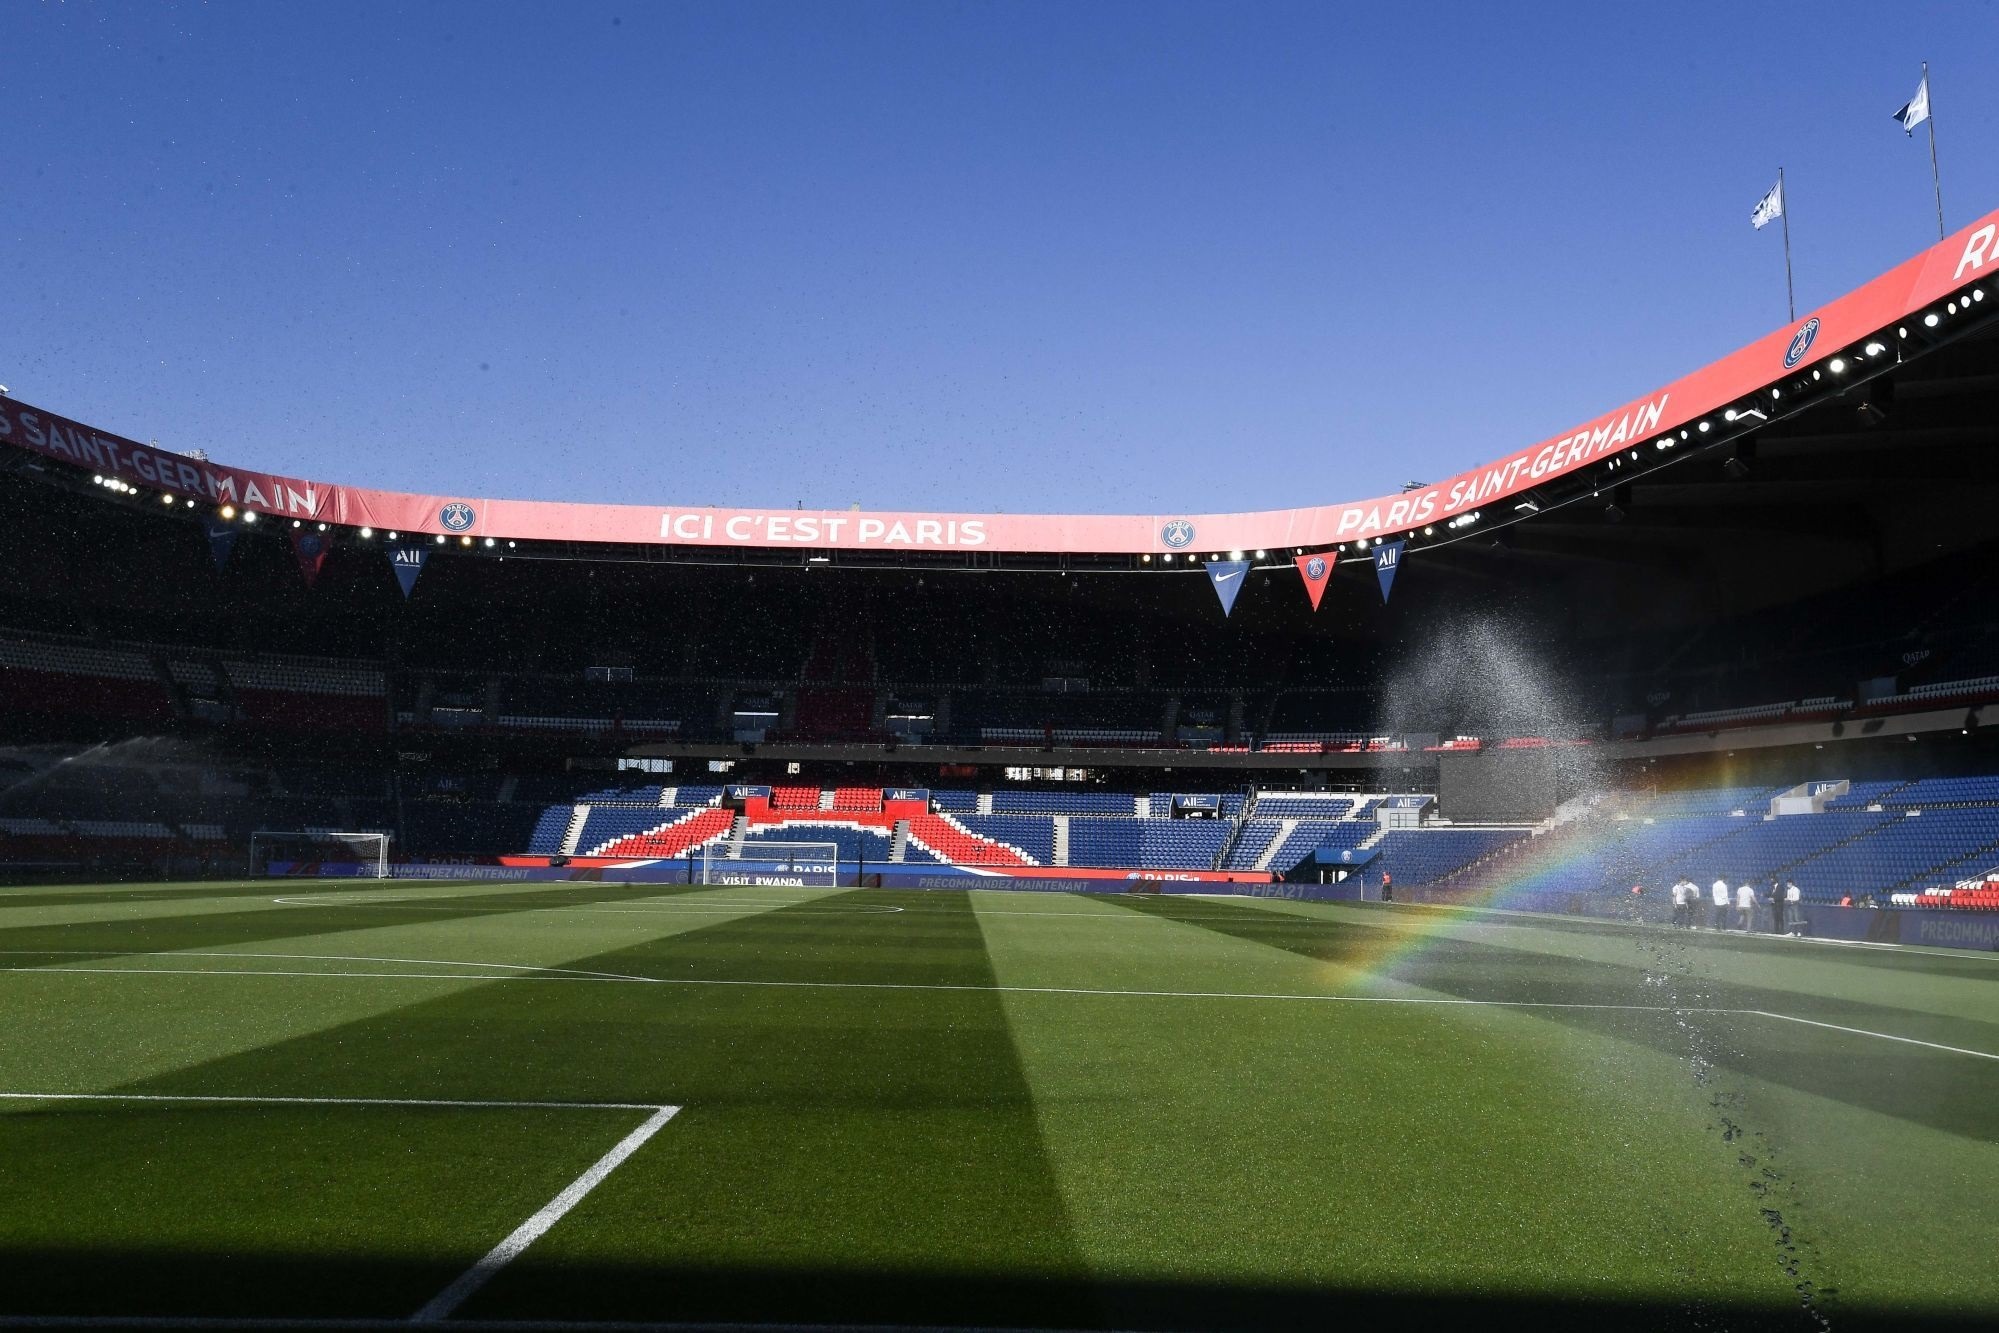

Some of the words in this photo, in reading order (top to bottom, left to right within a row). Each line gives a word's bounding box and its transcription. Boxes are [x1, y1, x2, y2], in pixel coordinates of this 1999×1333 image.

[1952, 223, 1999, 281] R
[19, 411, 317, 516] SAINT-GERMAIN
[1336, 491, 1439, 536] PARIS
[1443, 393, 1670, 511] SAINT-GERMAIN
[660, 514, 713, 539] ICI
[725, 515, 848, 542] C'EST
[859, 519, 986, 545] PARIS
[453, 868, 529, 880] MAINTENANT
[722, 876, 749, 886] VISIT
[755, 876, 803, 887] RWANDA
[1014, 879, 1089, 892] MAINTENANT
